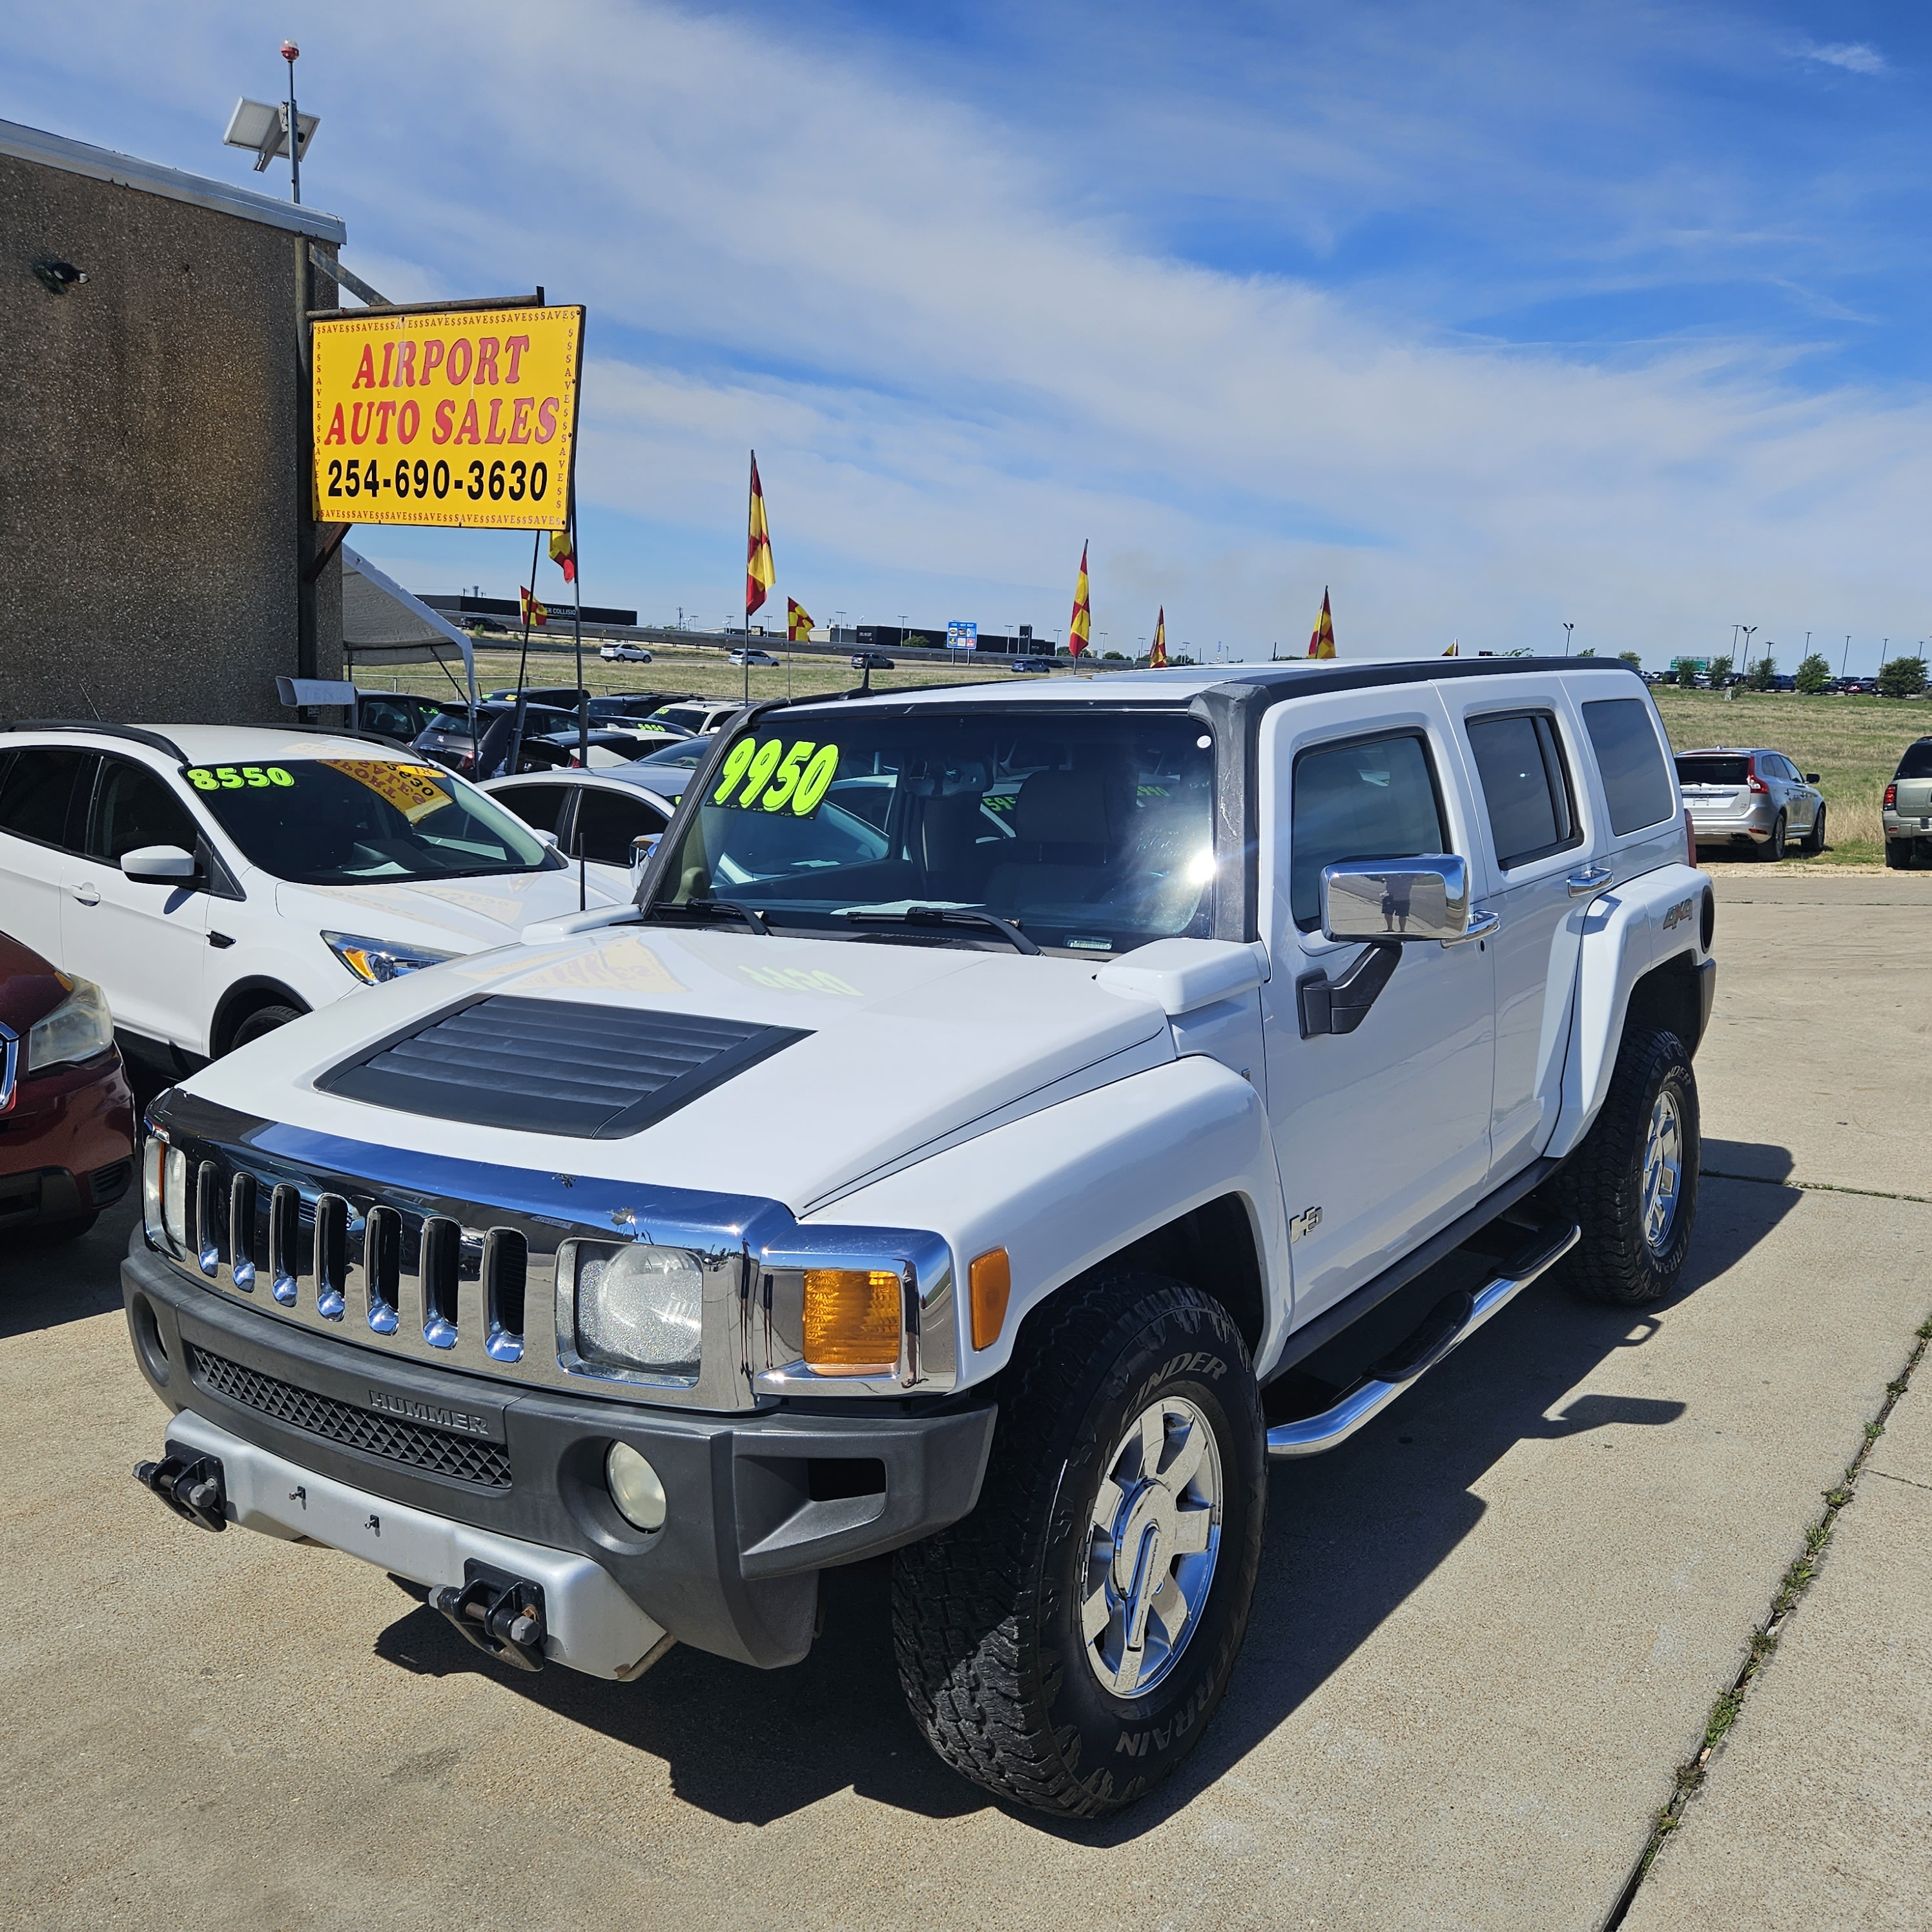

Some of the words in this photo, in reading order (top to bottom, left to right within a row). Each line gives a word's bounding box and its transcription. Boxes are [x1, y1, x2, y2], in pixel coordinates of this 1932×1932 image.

[351, 334, 529, 389] AIRPORT
[324, 398, 421, 446] AUTO
[431, 396, 559, 445] SALES
[327, 459, 548, 501] 254-690-3630
[552, 607, 577, 615] COLLISIO
[637, 723, 666, 732] 5950
[187, 767, 295, 791] 8550
[714, 737, 839, 816] 9950
[982, 796, 1016, 811] 595
[368, 1390, 489, 1436] HUMMER
